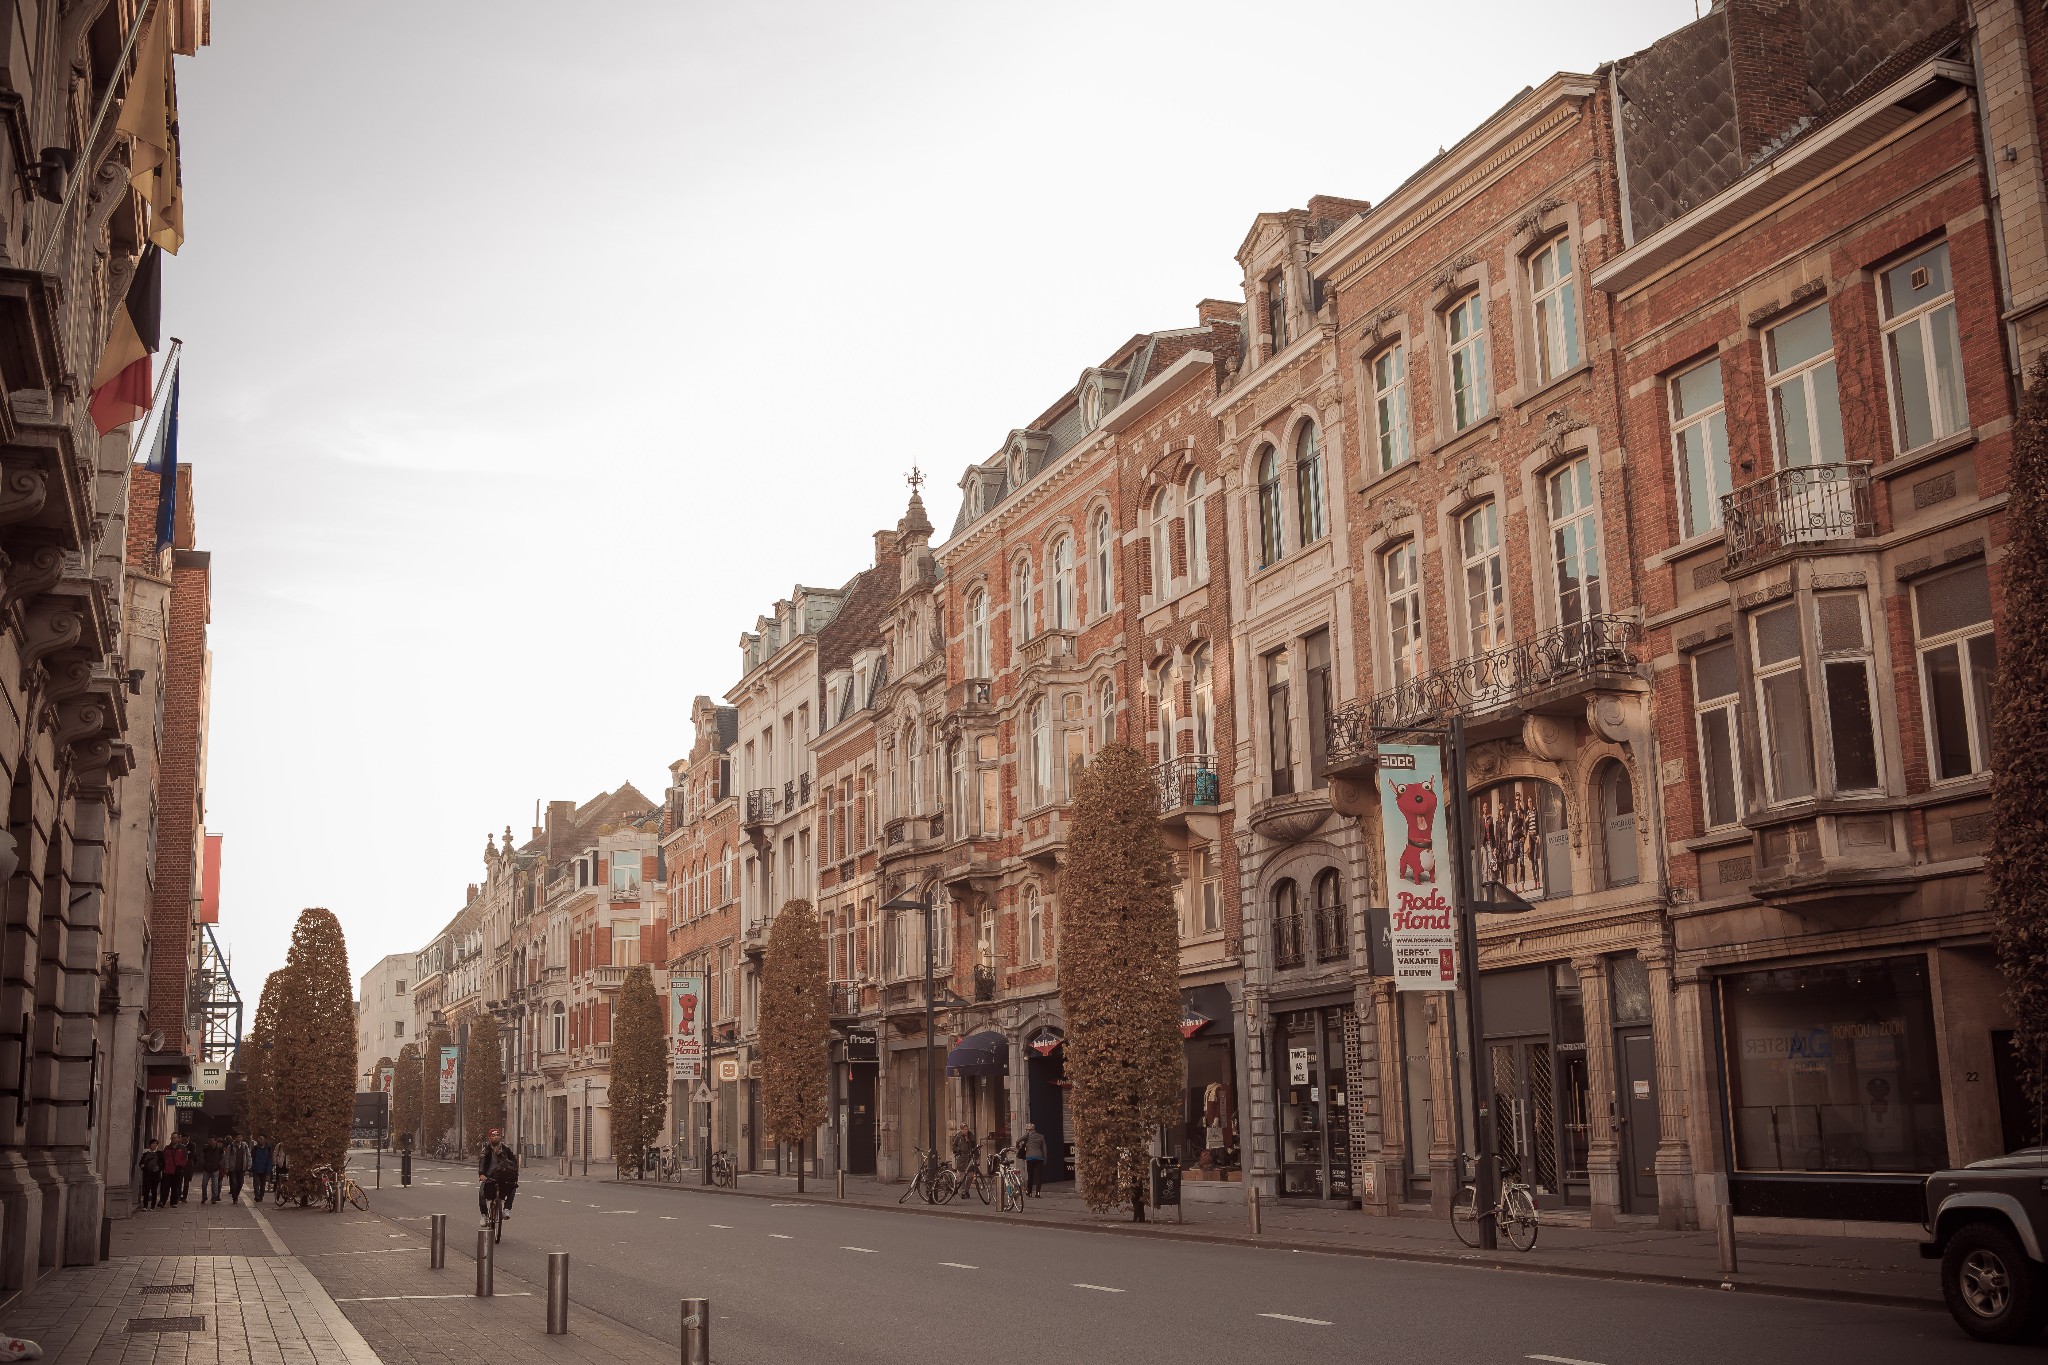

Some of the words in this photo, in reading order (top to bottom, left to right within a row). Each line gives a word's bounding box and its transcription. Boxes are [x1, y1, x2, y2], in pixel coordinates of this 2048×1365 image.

[1397, 887, 1447, 912] Rode
[1393, 905, 1452, 931] Hond
[1397, 949, 1432, 957] HERFST-
[1398, 957, 1439, 965] VAKANTIE
[1398, 969, 1432, 977] LEUVEN
[1833, 1024, 1870, 1040] RONDOU
[1880, 1020, 1905, 1037] ZOON
[676, 1036, 699, 1047] Rode
[849, 1034, 876, 1044] fnac
[1295, 1062, 1303, 1070] AS
[1966, 1071, 1980, 1082] 22
